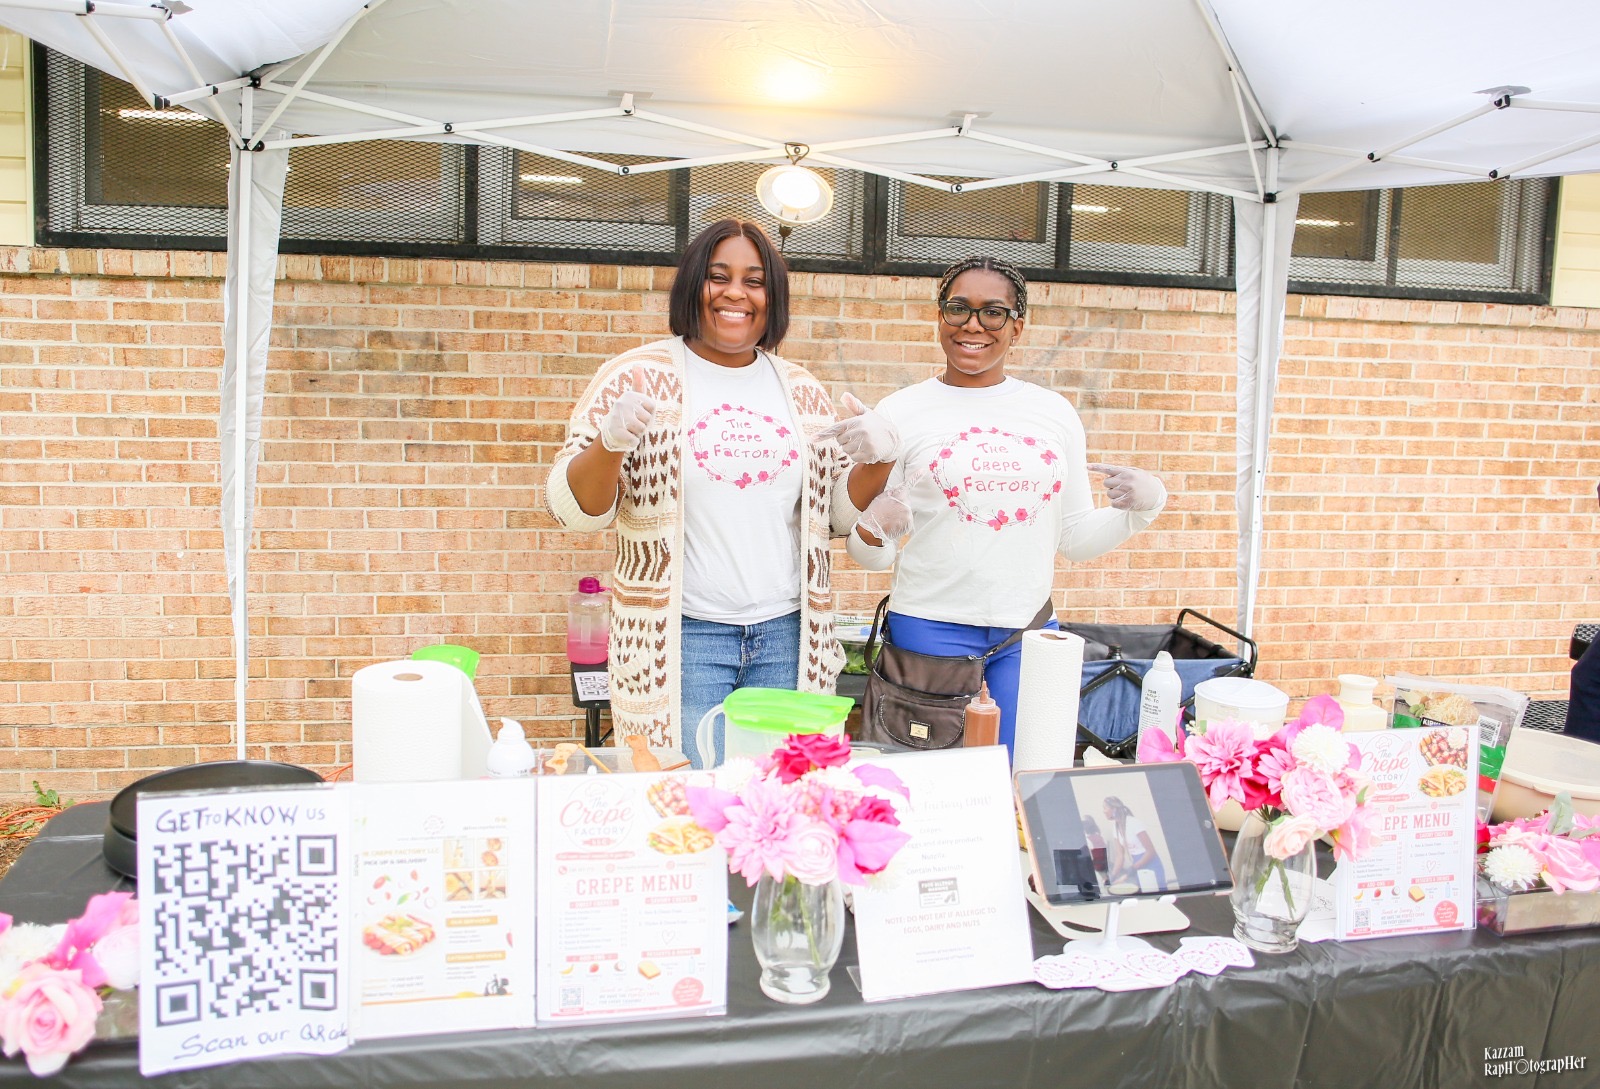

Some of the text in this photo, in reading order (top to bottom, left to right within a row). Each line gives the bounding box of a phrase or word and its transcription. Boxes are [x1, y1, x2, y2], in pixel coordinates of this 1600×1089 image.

[1371, 773, 1404, 782] ACTORY
[156, 805, 326, 835] GET TO KNOW US
[1384, 812, 1451, 831] EPE MENU
[574, 826, 625, 836] FACTORY
[576, 873, 693, 895] CREPE MENU
[885, 916, 906, 926] NOTE:
[906, 914, 918, 923] DO
[919, 912, 933, 921] NOT
[935, 911, 946, 920] EAT
[955, 907, 986, 917] ALLERGIC
[987, 906, 997, 914] TO
[903, 919, 981, 935] EGGS, DAIRY AND NUTS
[173, 1034, 249, 1061] Scan
[257, 1029, 290, 1046] our
[299, 1023, 326, 1042] QR
